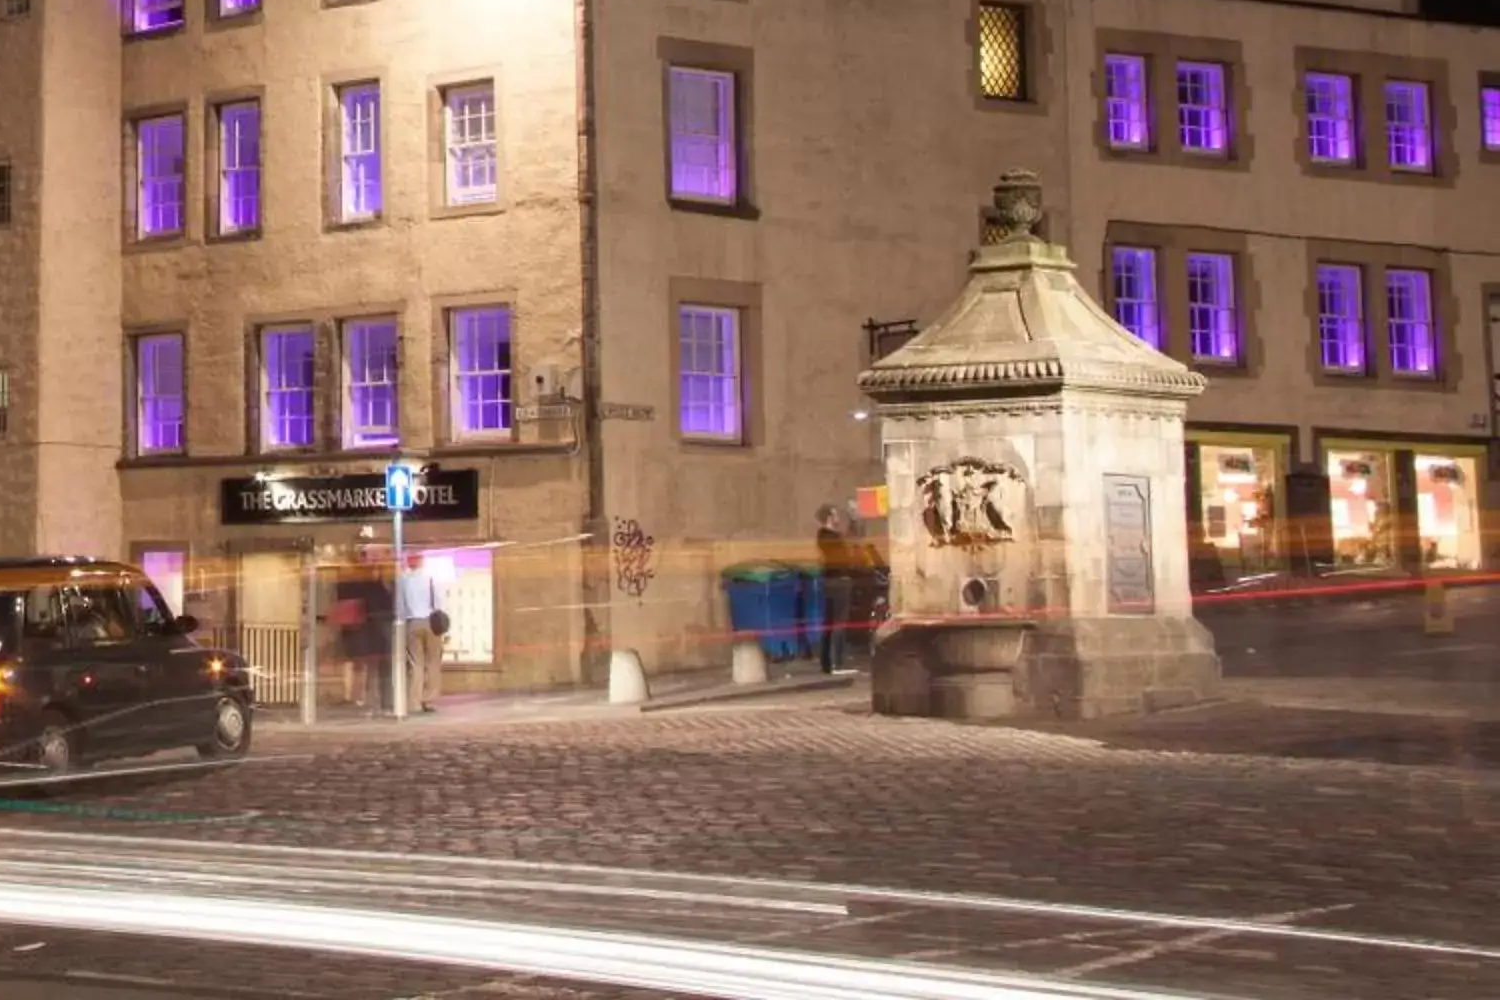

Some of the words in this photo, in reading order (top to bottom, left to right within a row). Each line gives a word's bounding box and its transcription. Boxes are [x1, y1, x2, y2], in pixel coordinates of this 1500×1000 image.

[242, 490, 271, 511] THE
[273, 486, 386, 511] GRASSMARKE
[412, 485, 459, 505] OTEL
